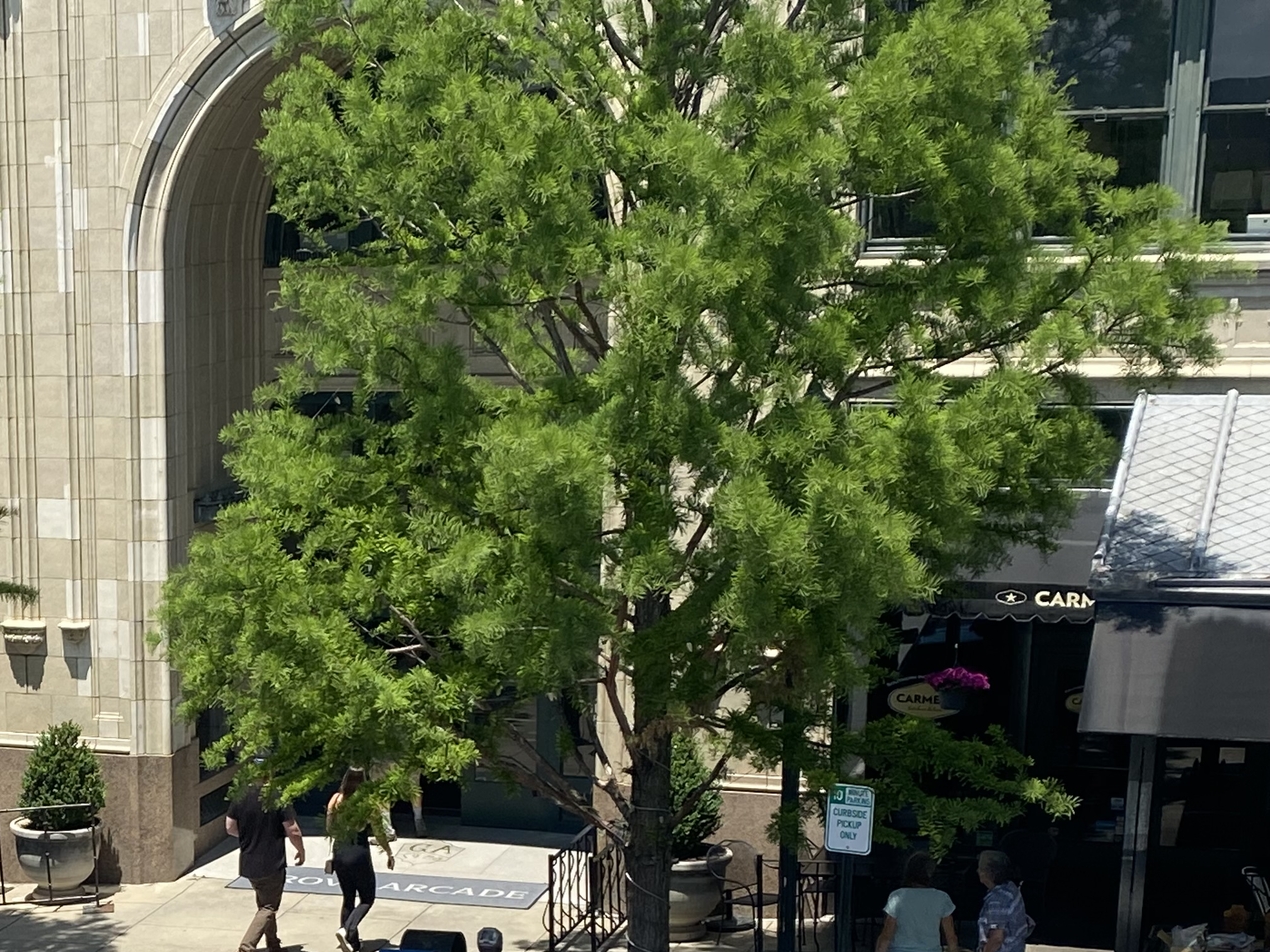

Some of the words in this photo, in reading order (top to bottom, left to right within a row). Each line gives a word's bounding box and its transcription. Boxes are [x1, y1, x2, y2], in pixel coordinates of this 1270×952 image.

[1034, 590, 1096, 609] CARM
[896, 693, 941, 705] CARME
[833, 807, 868, 819] CURBSIDE
[836, 818, 862, 829] PICKUP
[839, 830, 858, 840] ONLY
[377, 881, 530, 900] ARCADE
